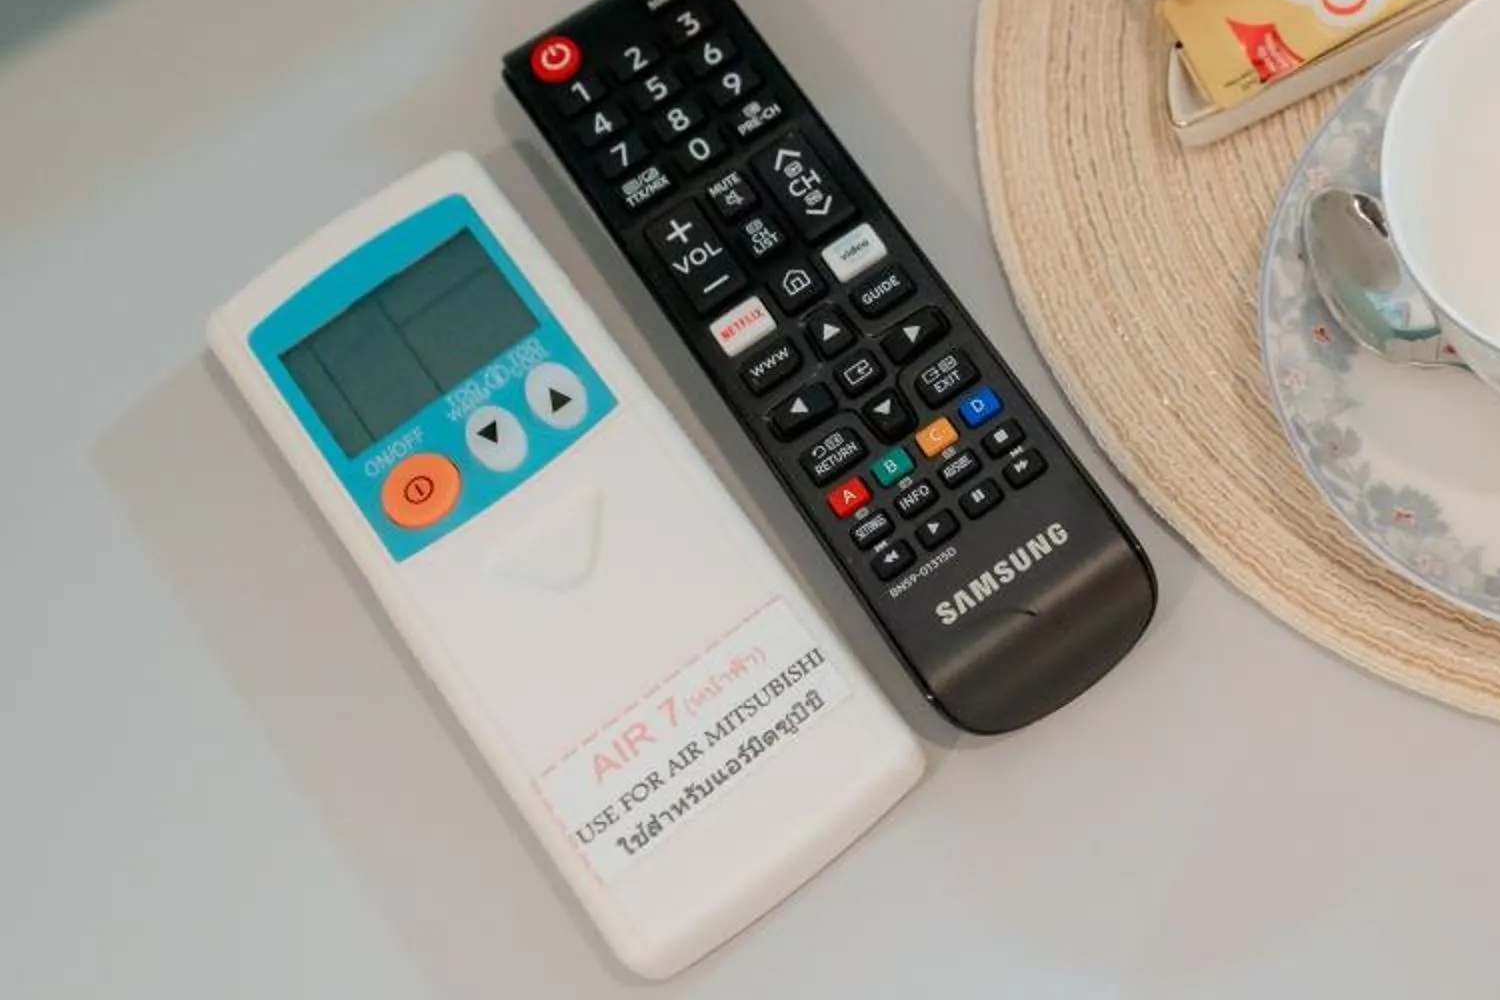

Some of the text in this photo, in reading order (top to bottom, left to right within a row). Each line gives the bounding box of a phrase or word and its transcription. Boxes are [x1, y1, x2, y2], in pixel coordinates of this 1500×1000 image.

[677, 11, 700, 36] 3
[624, 46, 648, 71] 2
[703, 42, 723, 65] 6
[571, 81, 591, 103] 1
[645, 75, 668, 101] 5
[722, 73, 741, 95] 9
[593, 112, 614, 136] 4
[667, 107, 689, 132] 8
[610, 142, 629, 167] 7
[688, 138, 711, 161] 0
[708, 171, 741, 198] MUTE
[788, 169, 823, 197] CH
[750, 224, 772, 245] CH
[752, 232, 781, 256] LIST
[672, 242, 723, 275] VOL
[861, 275, 901, 305] GUIDE
[720, 308, 764, 341] NETFLIX
[933, 371, 961, 393] EXIT
[972, 399, 985, 413] D
[929, 428, 943, 443] C
[364, 427, 425, 478] ON/OFF
[815, 441, 858, 477] RETURN
[883, 458, 898, 474] B
[842, 489, 856, 504] A
[898, 485, 930, 510] INFO
[935, 522, 1069, 625] SAMSUNG
[576, 647, 825, 845] USE FOR AIR MITSUBISHI
[592, 721, 657, 784] AIR
[656, 697, 681, 727] 7
